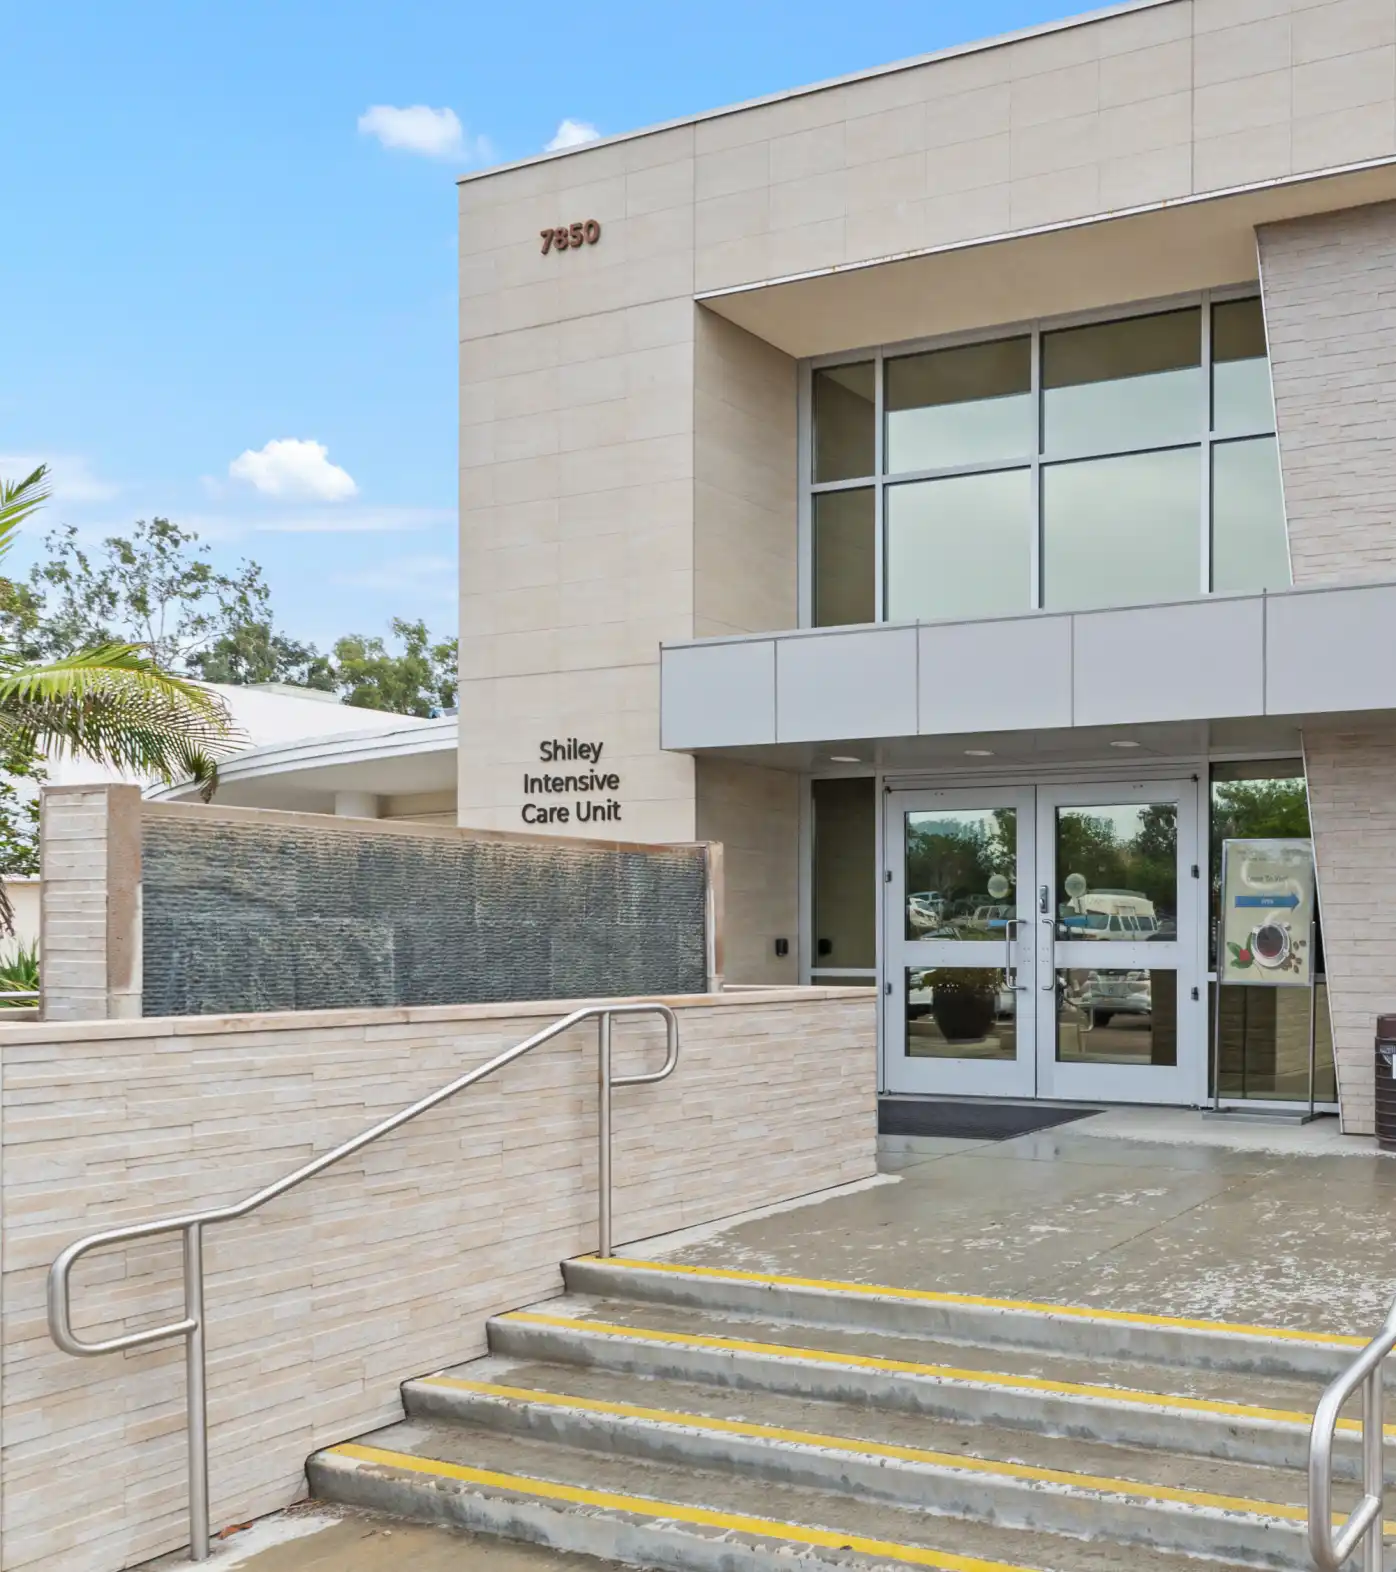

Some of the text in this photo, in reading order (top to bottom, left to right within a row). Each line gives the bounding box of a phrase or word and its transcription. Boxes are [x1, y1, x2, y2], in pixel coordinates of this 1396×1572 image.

[540, 219, 601, 255] 7850
[539, 737, 604, 764] Shiley
[523, 768, 620, 794] Intensive
[521, 798, 622, 824] Care Unit
